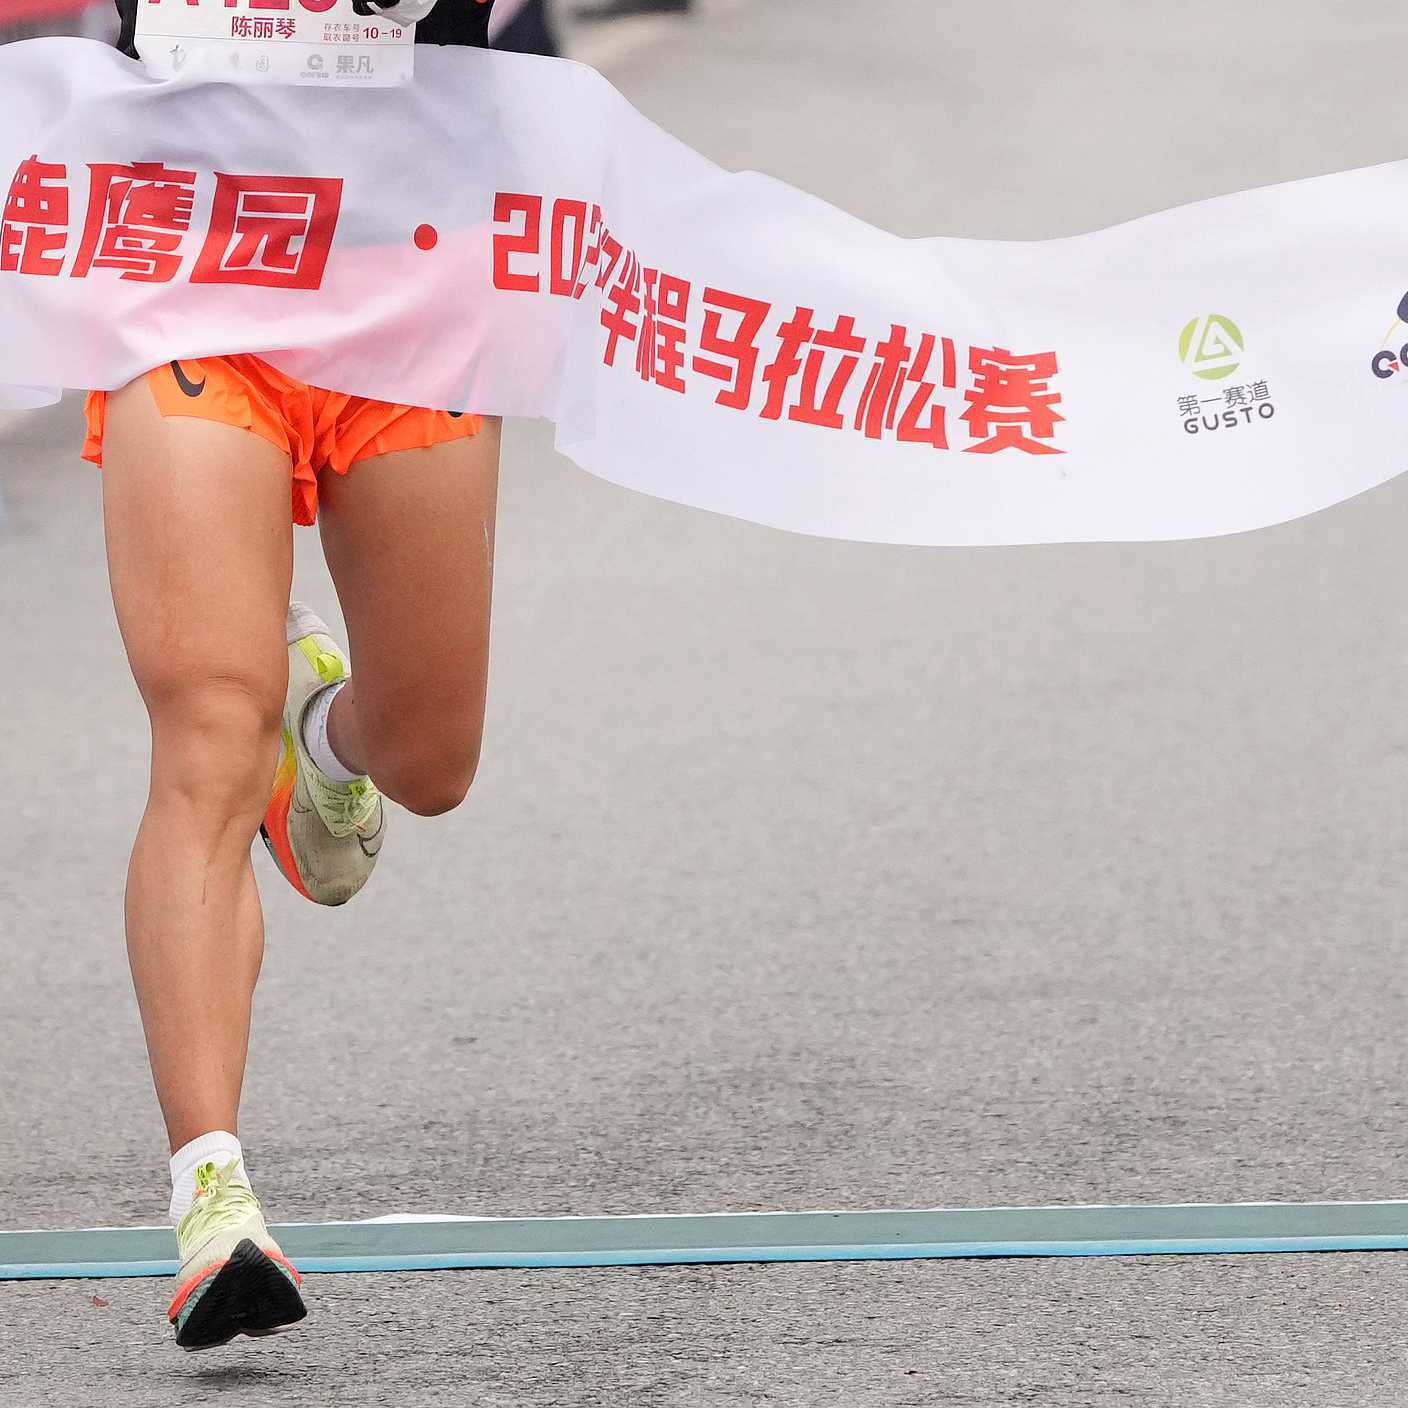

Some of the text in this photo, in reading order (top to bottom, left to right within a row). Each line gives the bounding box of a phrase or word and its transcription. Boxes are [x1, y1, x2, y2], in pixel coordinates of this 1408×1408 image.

[231, 16, 297, 39] 陈丽琴
[1176, 379, 1272, 417] 第一赛道
[1183, 403, 1275, 435] GUSTO
